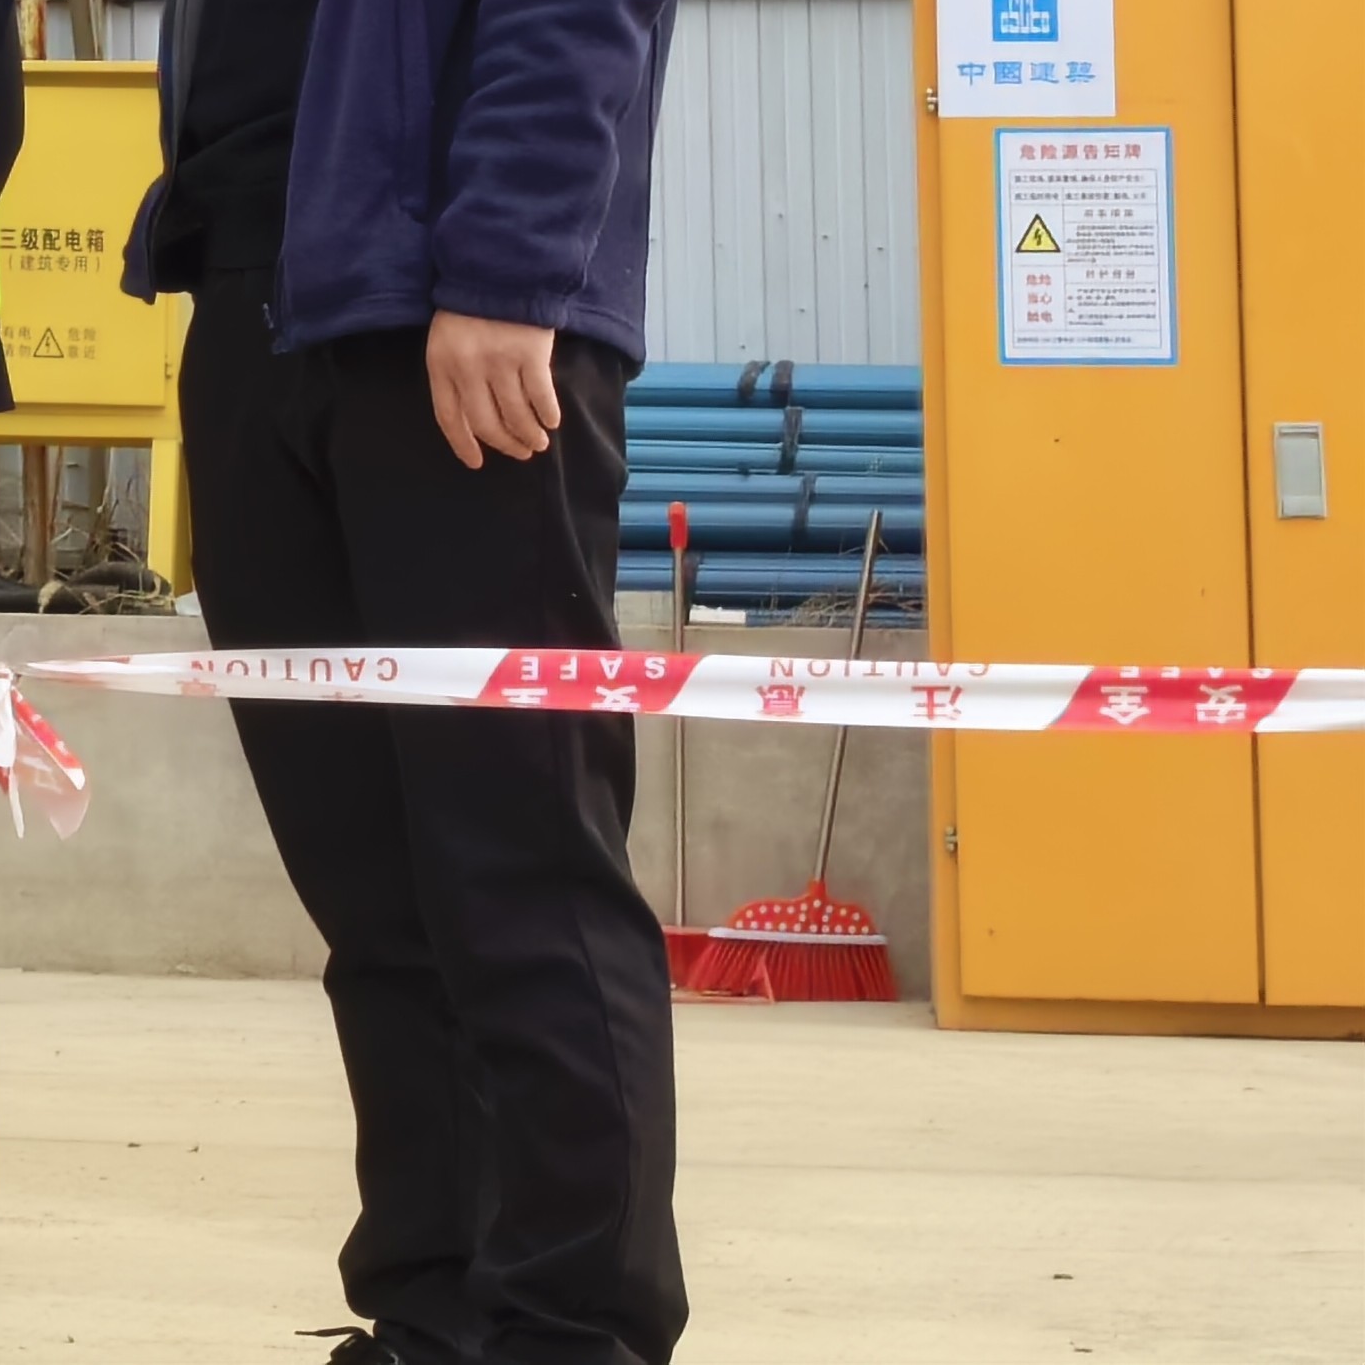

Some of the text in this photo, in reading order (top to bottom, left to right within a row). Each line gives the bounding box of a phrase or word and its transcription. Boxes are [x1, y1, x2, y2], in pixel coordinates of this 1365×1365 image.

[0, 228, 104, 253] 三级配电箱
[520, 656, 667, 681] SAFE
